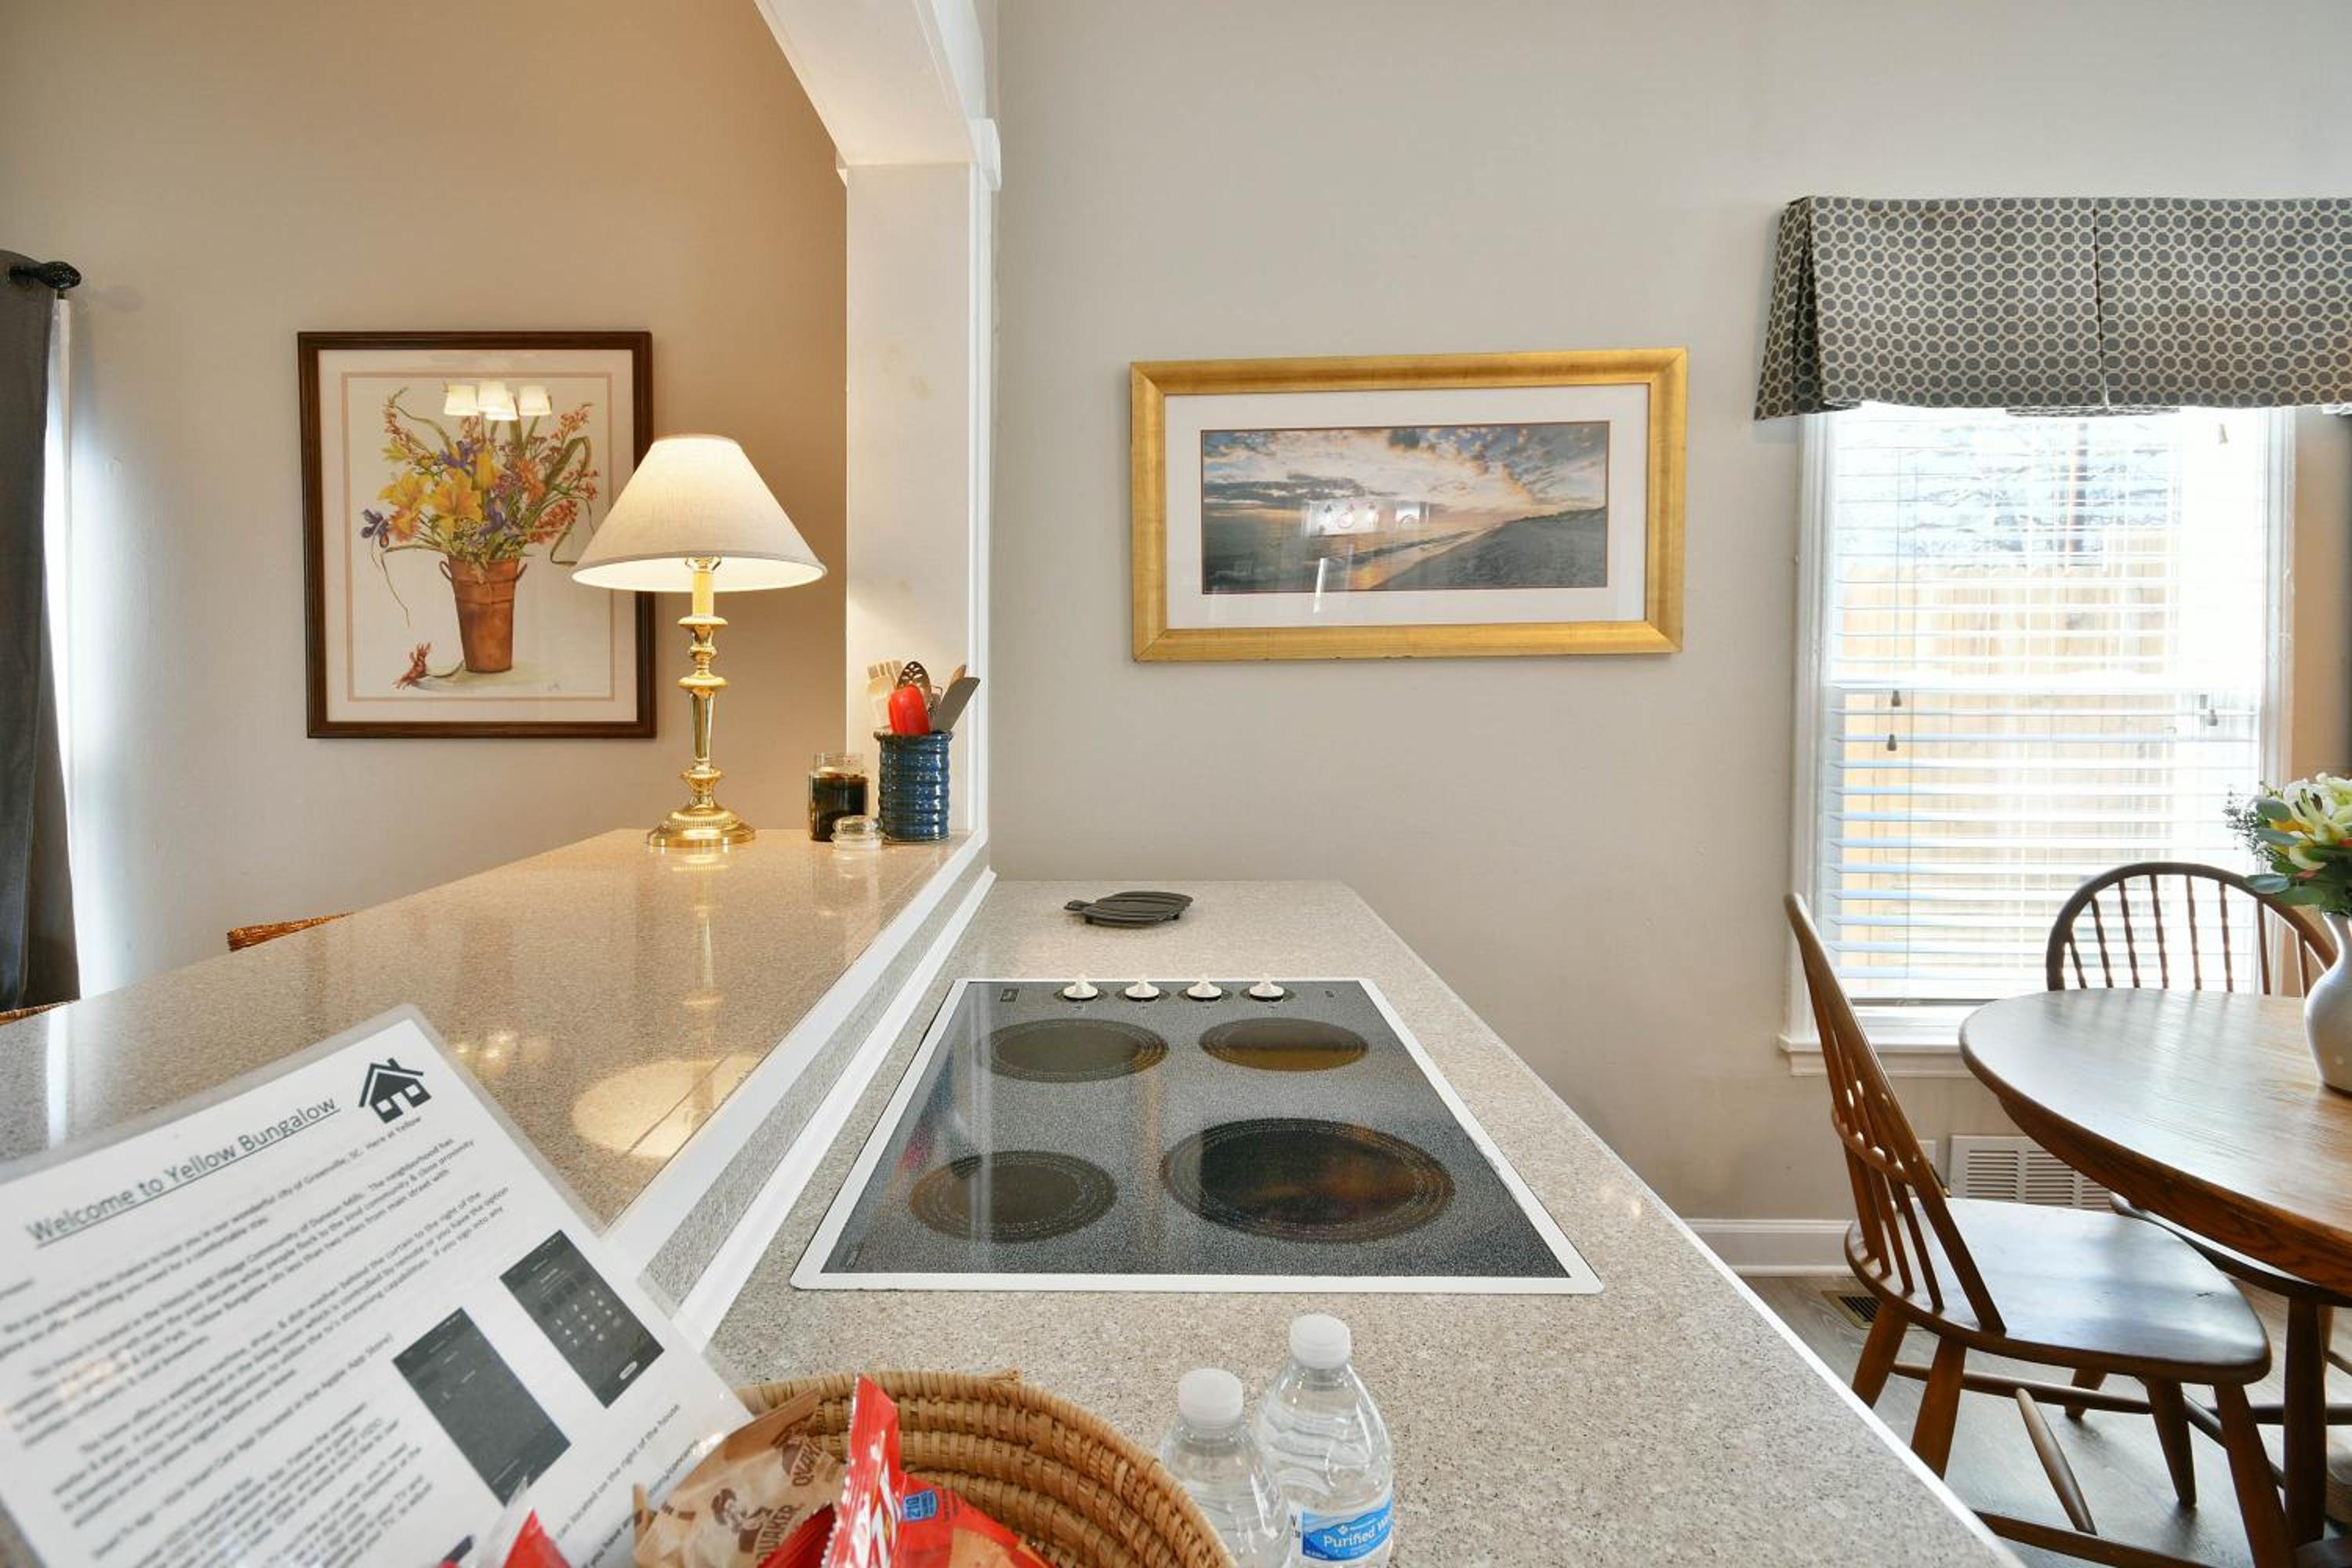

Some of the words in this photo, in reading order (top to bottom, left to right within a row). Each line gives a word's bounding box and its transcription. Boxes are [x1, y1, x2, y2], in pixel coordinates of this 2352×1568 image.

[25, 1187, 136, 1243] Welcome
[139, 1179, 164, 1200] to
[164, 1142, 235, 1185] Yellow
[238, 1096, 336, 1153] Bungalow
[905, 1496, 920, 1519] 210
[1323, 1526, 1376, 1548] Purified
